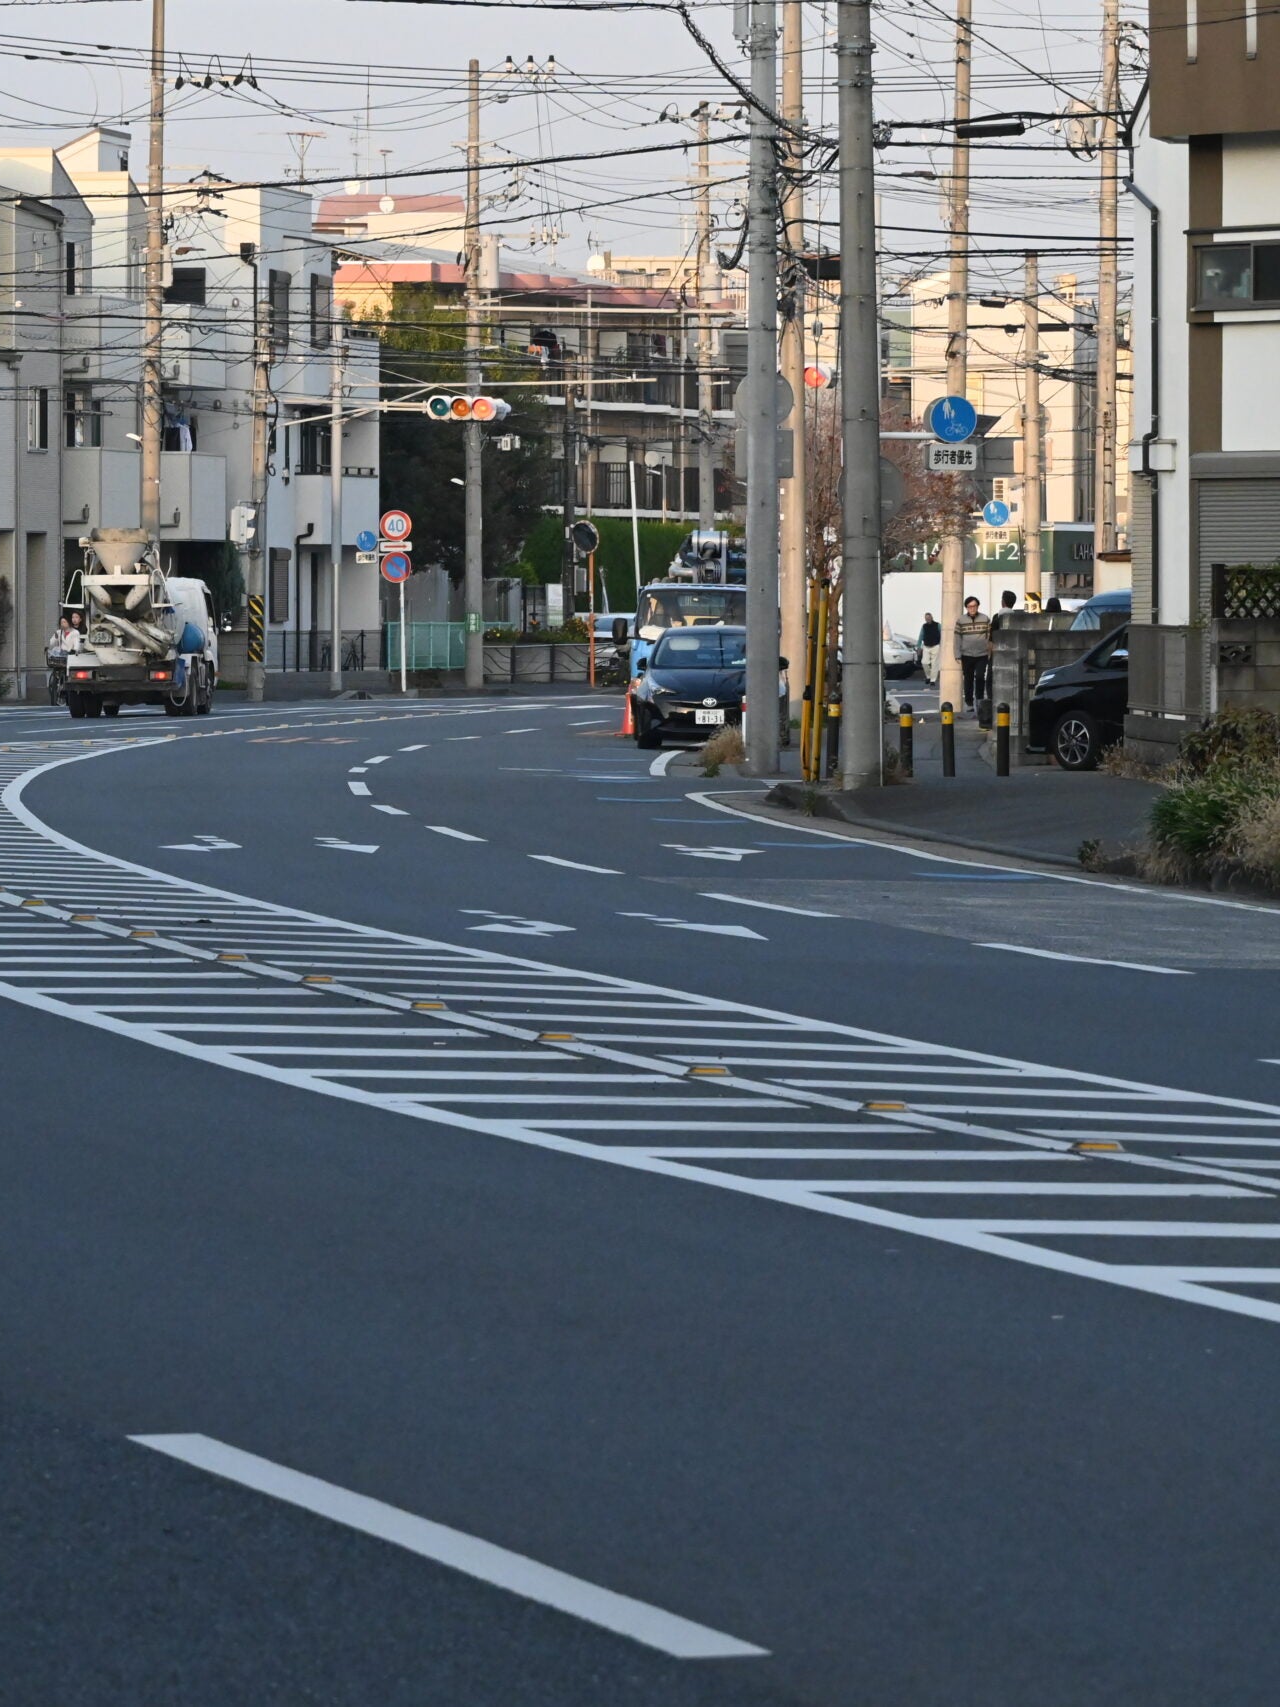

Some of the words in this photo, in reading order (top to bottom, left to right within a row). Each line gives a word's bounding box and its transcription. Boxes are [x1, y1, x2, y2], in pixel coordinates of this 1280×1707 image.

[933, 449, 973, 465] 歩行者優先
[387, 519, 405, 532] 40
